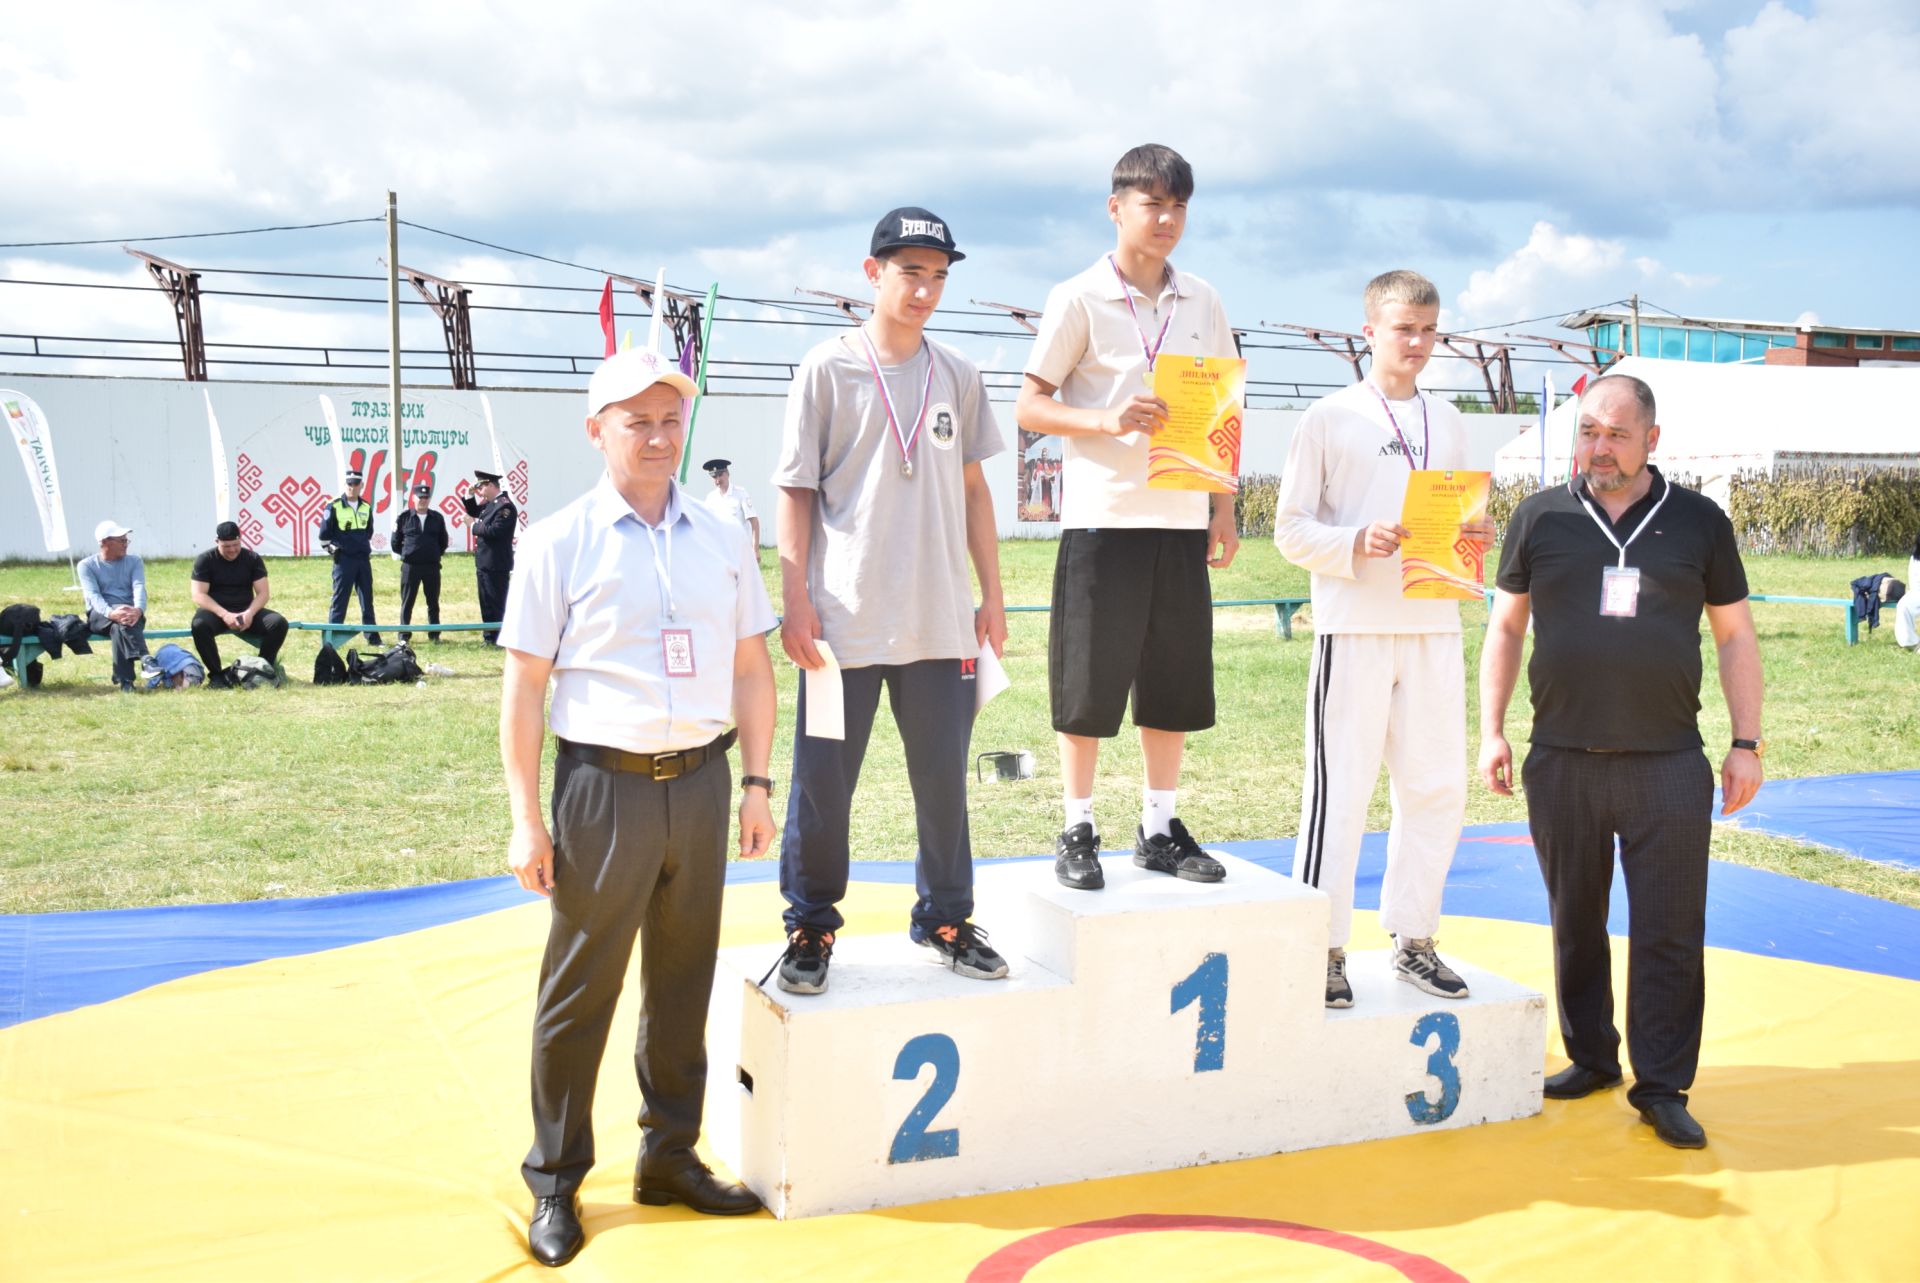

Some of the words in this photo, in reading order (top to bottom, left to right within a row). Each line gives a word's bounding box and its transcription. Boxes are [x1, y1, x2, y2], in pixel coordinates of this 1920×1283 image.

[900, 217, 946, 243] EVERLAST
[1179, 370, 1220, 380] ДИПЛОМ
[351, 401, 425, 419] ПРАЗНИК
[304, 425, 389, 446] ЧУВШСКОЙ
[401, 429, 469, 449] УЛЬТУРЫ
[1171, 952, 1229, 1074] 1
[1405, 1011, 1463, 1126] 3
[887, 1032, 960, 1165] 2
